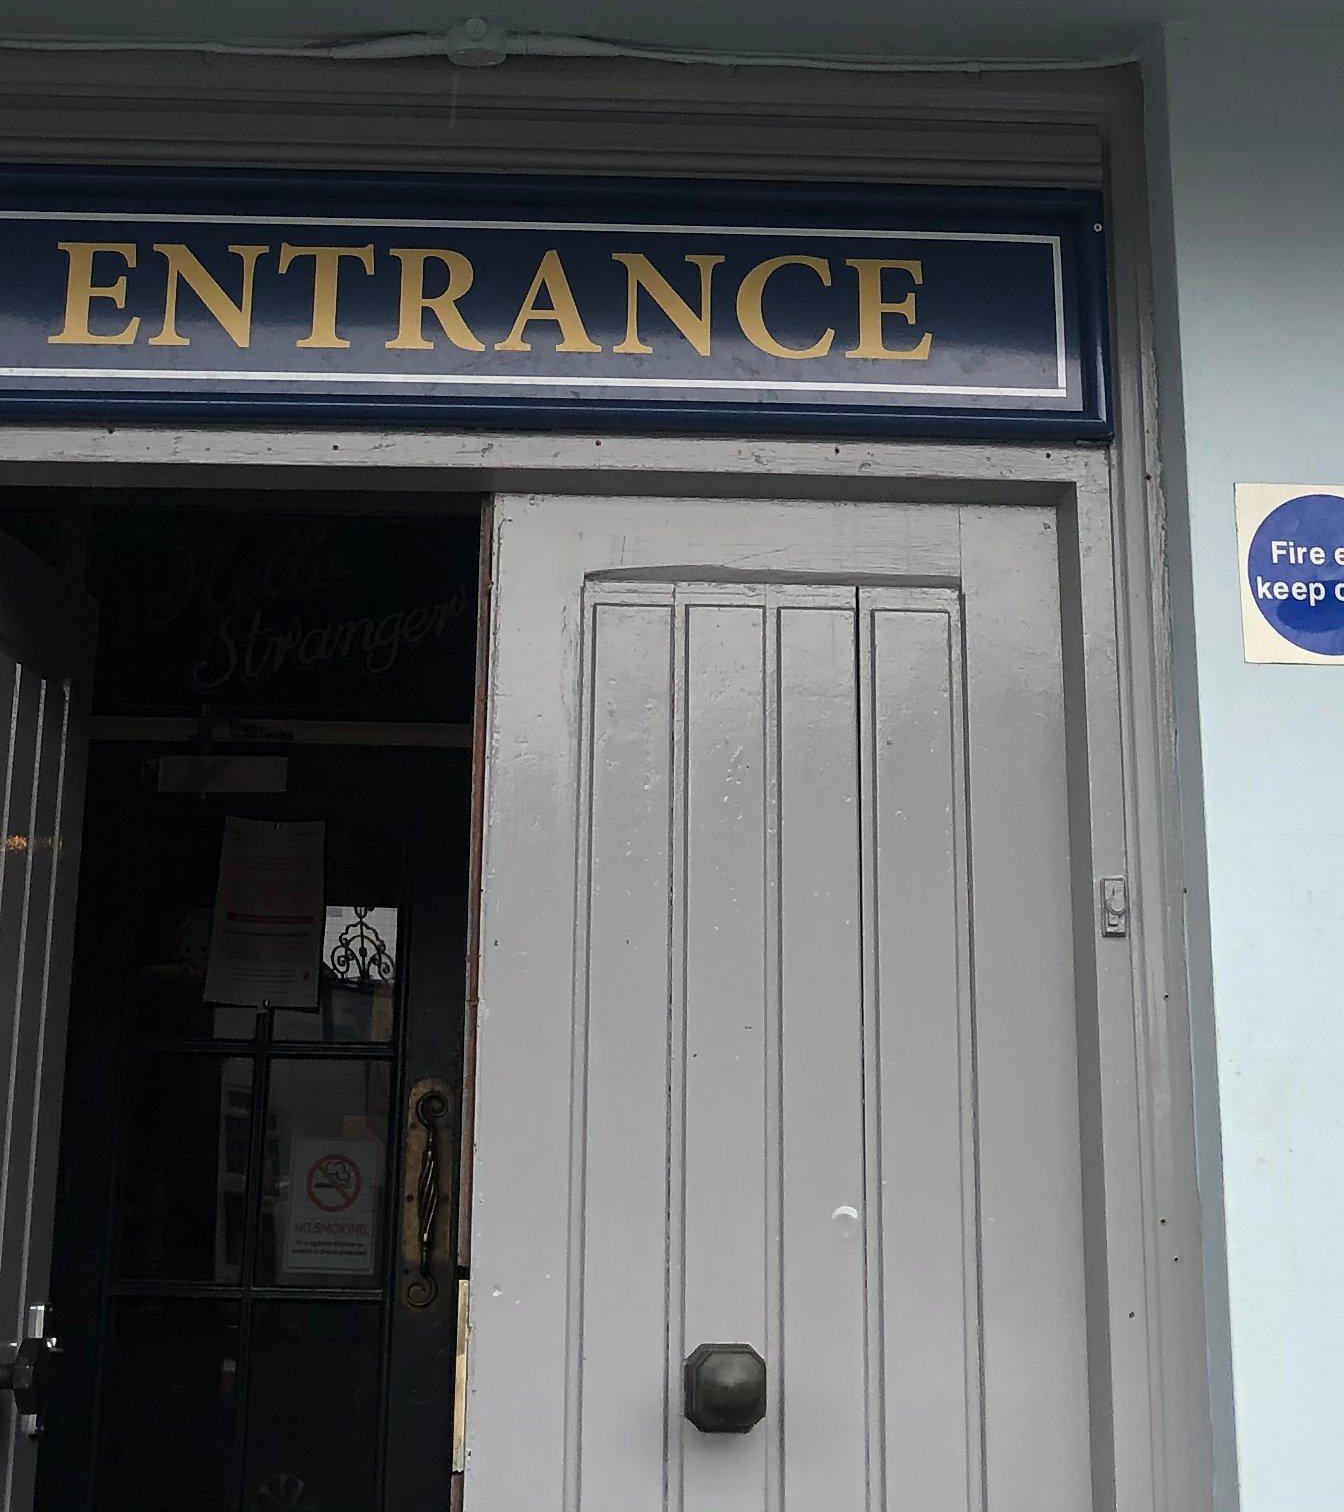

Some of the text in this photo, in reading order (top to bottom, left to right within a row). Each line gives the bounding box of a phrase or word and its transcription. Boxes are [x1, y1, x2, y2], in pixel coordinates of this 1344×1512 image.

[47, 239, 935, 360] ENTRANCE
[1271, 540, 1326, 566] Fire
[1256, 576, 1326, 606] keep
